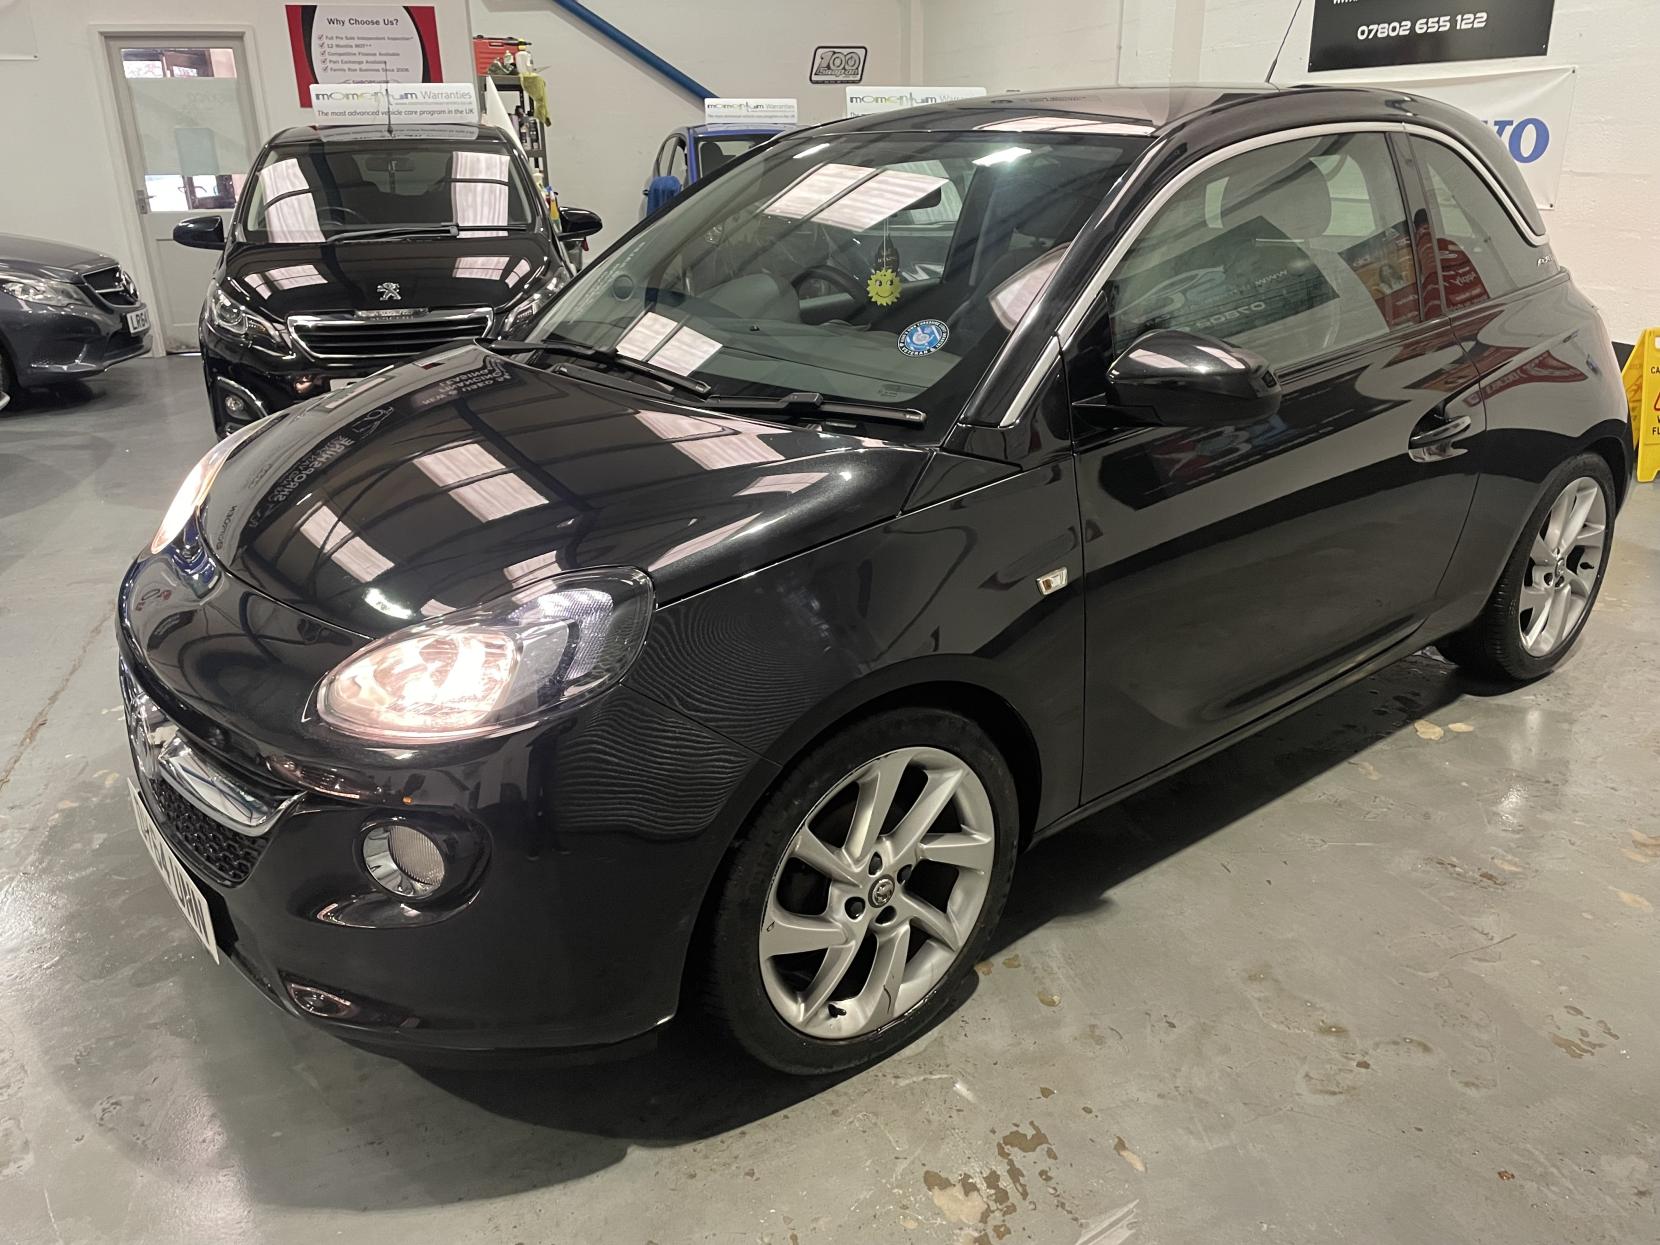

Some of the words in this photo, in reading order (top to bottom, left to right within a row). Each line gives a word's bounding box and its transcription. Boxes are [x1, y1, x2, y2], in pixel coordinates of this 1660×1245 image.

[327, 17, 346, 27] Why
[348, 17, 381, 26] Choose
[384, 18, 399, 26] Us?
[1357, 20, 1412, 40] 07802
[1415, 15, 1451, 34] 655
[1456, 11, 1488, 30] 122
[818, 50, 861, 70] 100
[420, 90, 472, 100] Warranties
[419, 109, 447, 117] program
[465, 107, 475, 115] UK
